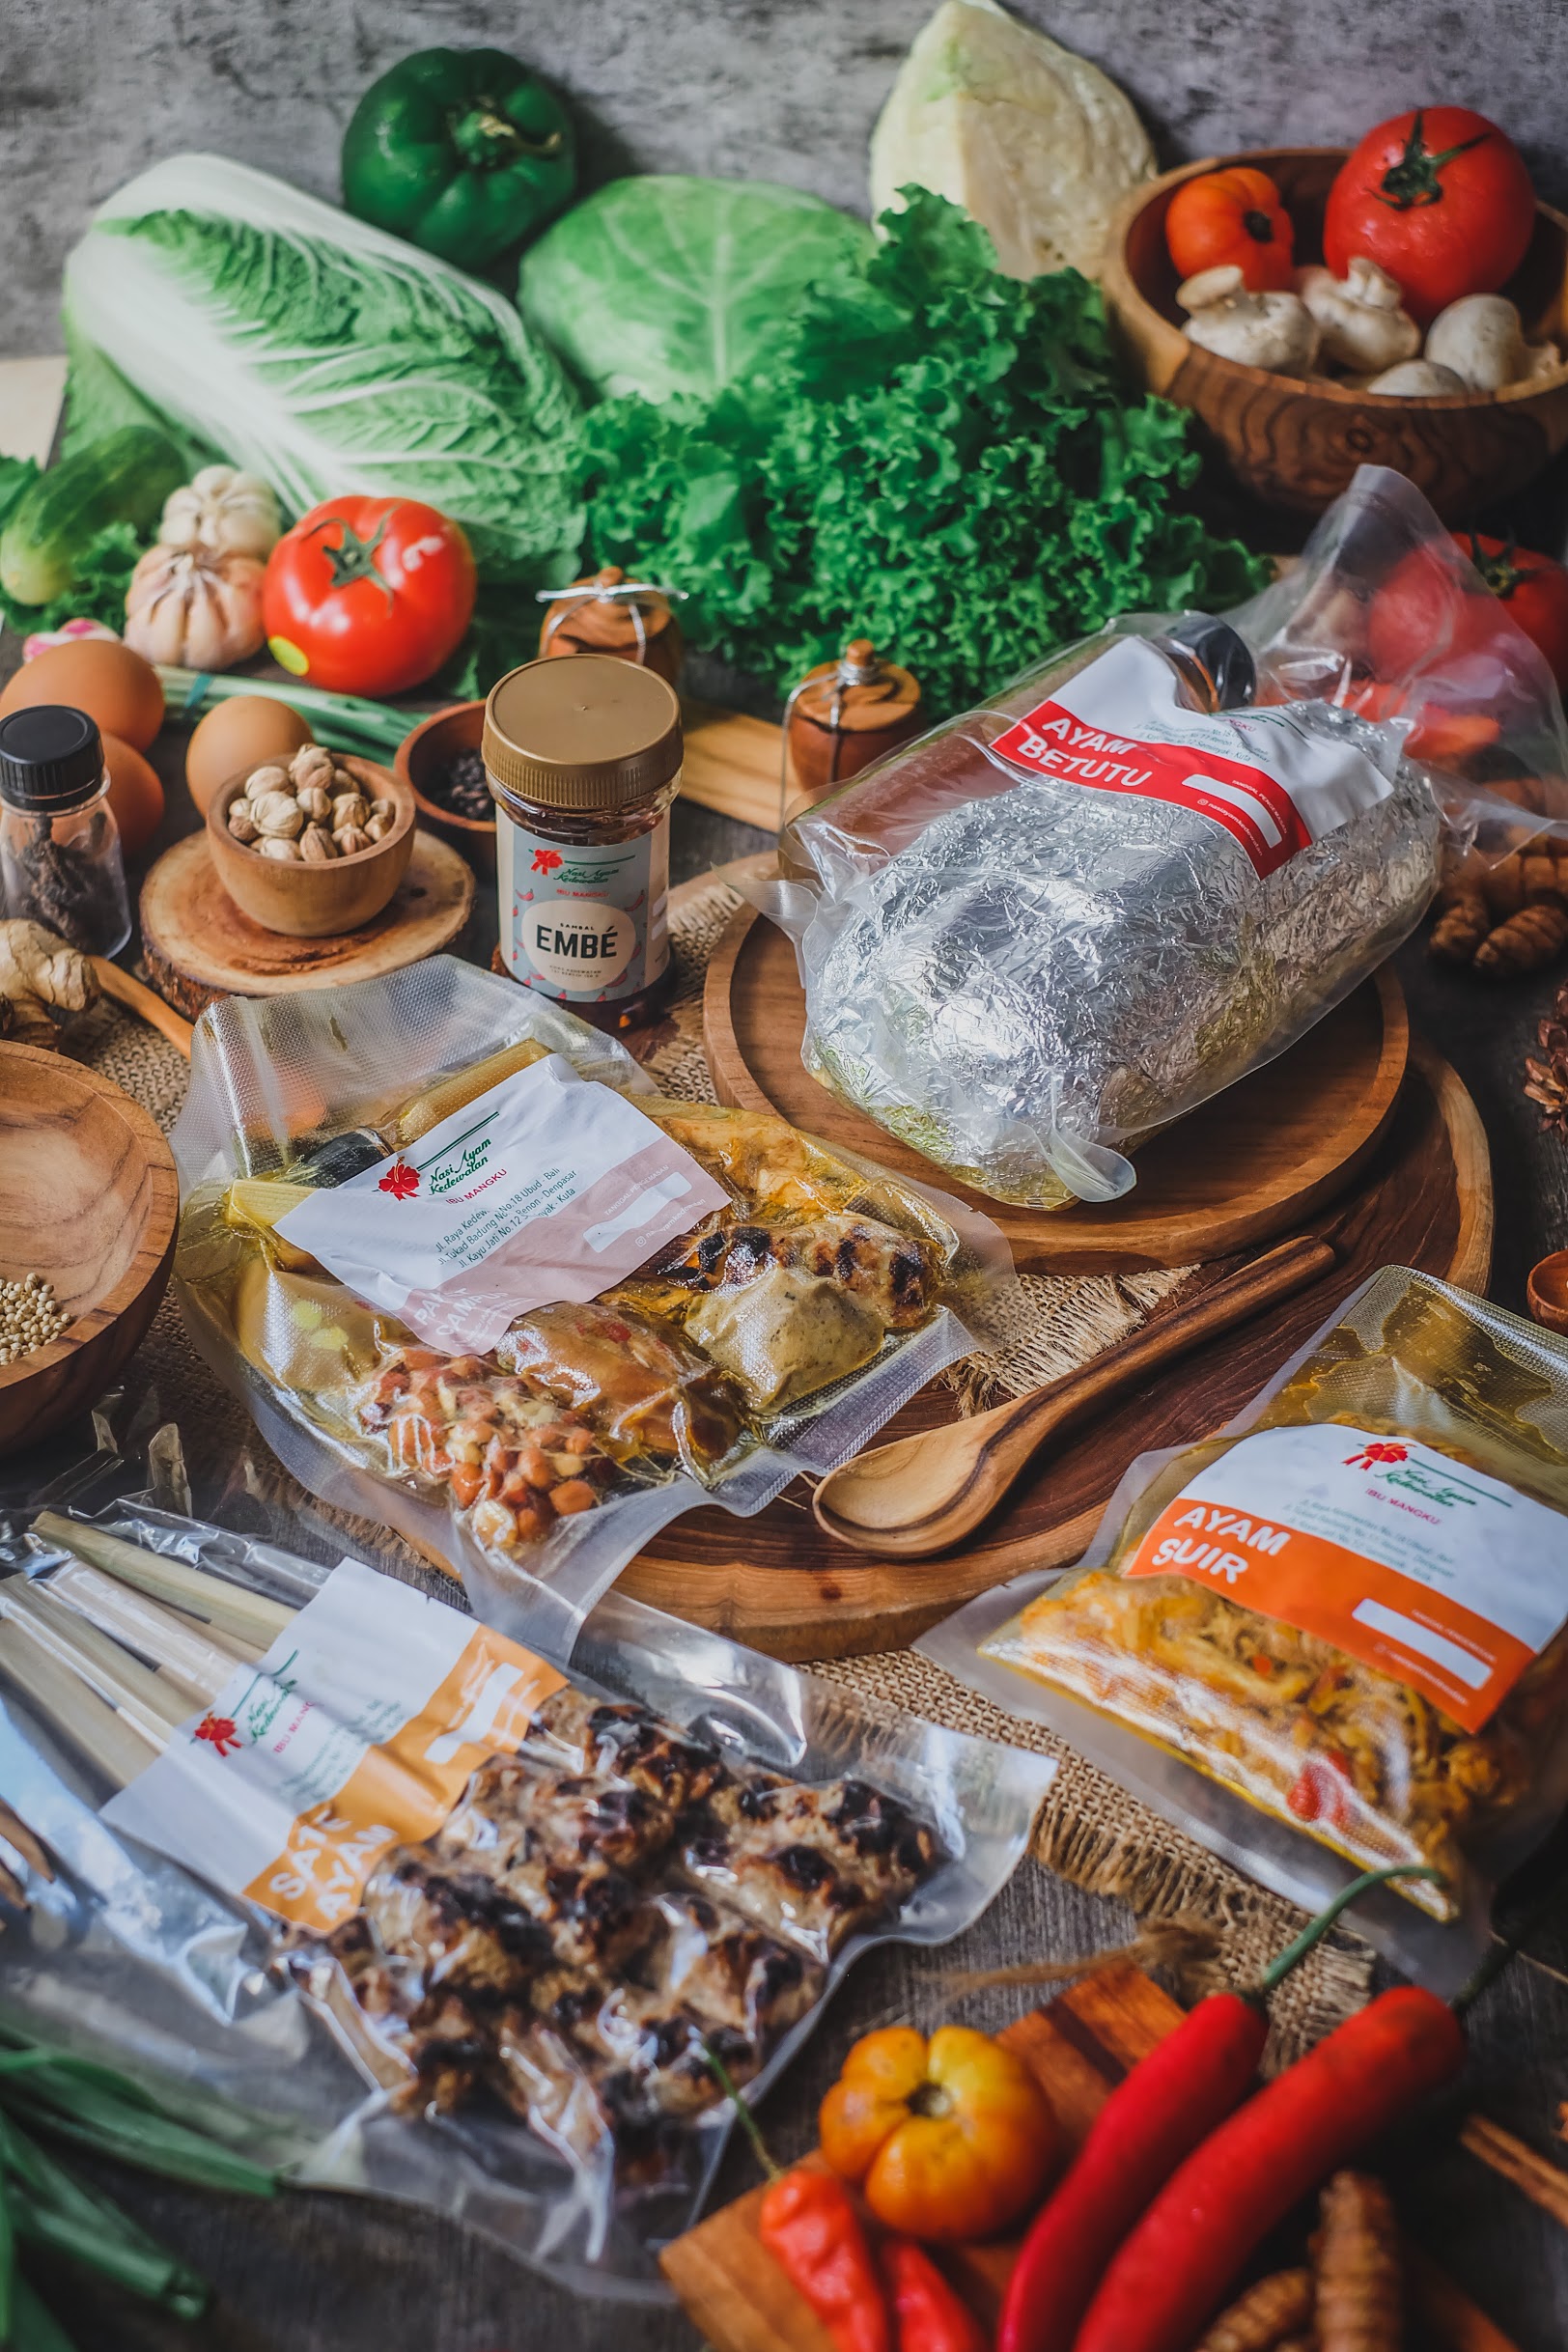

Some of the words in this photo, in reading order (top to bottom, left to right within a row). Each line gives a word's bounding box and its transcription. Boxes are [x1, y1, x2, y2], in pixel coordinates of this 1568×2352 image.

[1042, 717, 1138, 755] AYAM
[1017, 735, 1153, 787] BETUTU
[537, 924, 618, 959] EMBÉ
[560, 922, 595, 931] SAMBAL
[429, 1164, 454, 1186] Nasi
[454, 1138, 491, 1173] Ayam
[429, 1156, 489, 1196] Kedewatan
[435, 1242, 447, 1253] Jl.
[443, 1228, 464, 1245] Raya
[462, 1209, 491, 1230] Kedew
[519, 1179, 543, 1197] Ubud
[544, 1166, 560, 1180] Bali
[445, 1196, 464, 1205] IBU
[463, 1168, 508, 1200] MANGKU
[466, 1219, 498, 1245] Badung
[542, 1170, 577, 1198] Denpasar
[604, 1190, 632, 1217] TANGGAL
[466, 1246, 488, 1263] Kayu
[485, 1232, 500, 1249] Jati
[556, 1188, 575, 1203] Kuta
[1365, 1488, 1386, 1501] IBU
[1387, 1498, 1442, 1525] MANGKU
[1174, 1506, 1291, 1556] AYAM
[1152, 1538, 1248, 1584] SUIR
[316, 1824, 399, 1919] AYAM
